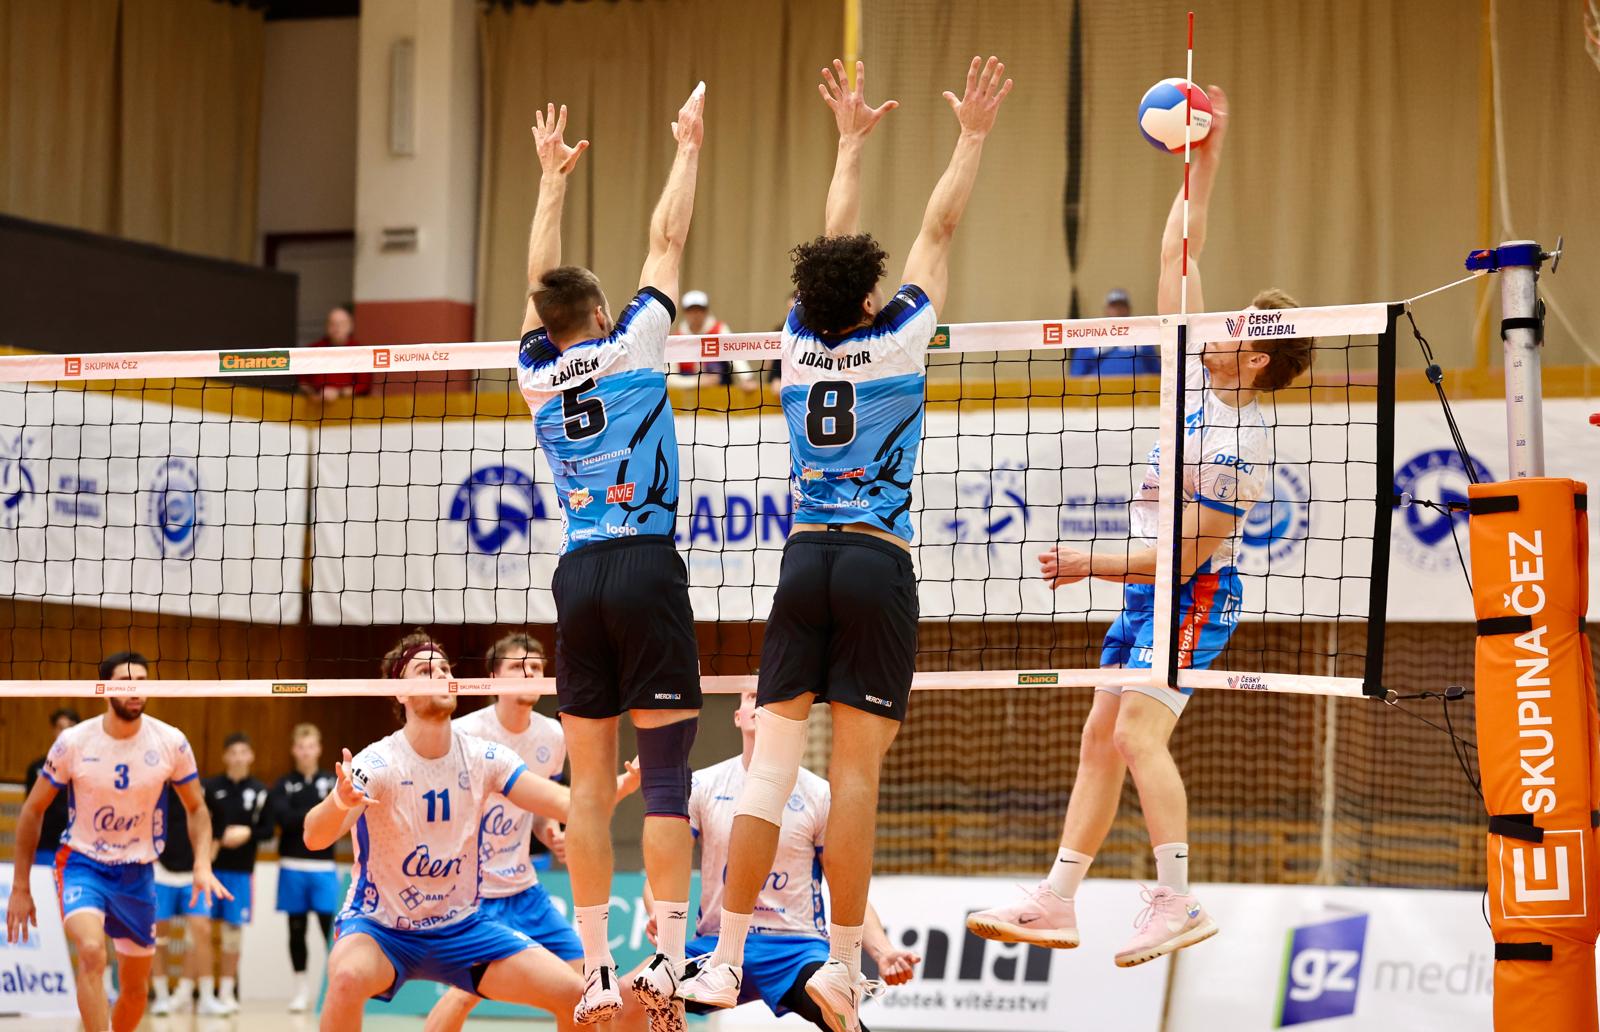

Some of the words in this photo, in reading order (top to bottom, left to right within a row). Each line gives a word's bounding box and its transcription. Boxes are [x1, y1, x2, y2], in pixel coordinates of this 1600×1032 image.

[1248, 313, 1282, 325] ČESKÝ
[1066, 328, 1108, 338] SKUPINA
[1110, 326, 1130, 337] ČEZ
[1247, 324, 1297, 337] VOLEJBAL
[723, 341, 762, 351] SKUPINA
[763, 339, 781, 350] ČEZ
[222, 354, 288, 370] Chance
[394, 353, 430, 362] SKUPINA
[432, 351, 449, 361] ČEZ
[798, 351, 834, 371] JOÃO
[84, 361, 120, 371] SKUPINA
[121, 360, 138, 370] ČEZ
[561, 377, 608, 442] 5
[805, 380, 857, 449] 8
[582, 447, 632, 466] Neumann
[607, 486, 634, 501] AVE
[674, 495, 793, 542] ADN
[606, 522, 638, 538] logio
[1503, 529, 1547, 617] ČEZ
[1019, 675, 1058, 683] Chance
[1239, 682, 1269, 691] VOLEJBAL
[273, 684, 306, 693] Chance
[1513, 625, 1556, 814] SKUPINA
[114, 764, 129, 790] 3
[422, 788, 450, 823] 11
[1288, 947, 1360, 1002] gz
[884, 989, 946, 1009] dotek
[951, 990, 1049, 1011] vítězství
